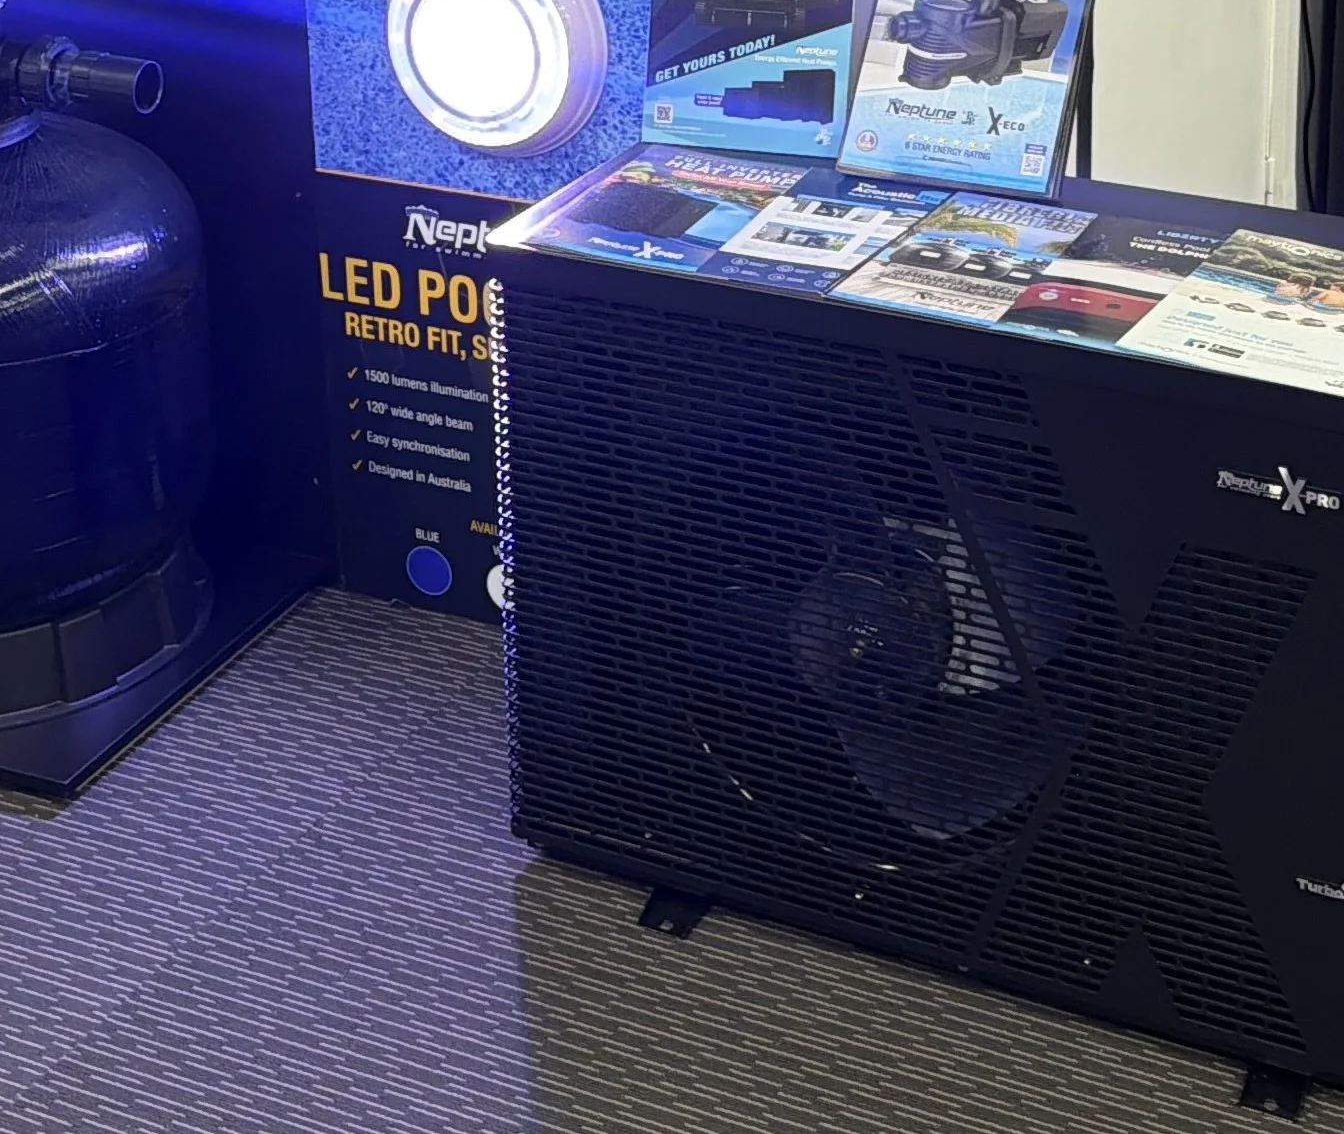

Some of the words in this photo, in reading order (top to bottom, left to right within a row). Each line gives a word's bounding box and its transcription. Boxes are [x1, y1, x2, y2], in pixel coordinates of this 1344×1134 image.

[655, 65, 680, 83] GET
[682, 51, 726, 75] YOURS
[728, 33, 776, 59] TODAY!
[885, 100, 957, 121] Neptune
[986, 106, 1026, 136] X-ECO
[912, 142, 931, 154] STAR
[932, 145, 963, 158] ENERGY
[963, 149, 991, 161] RATING
[664, 158, 724, 177] HEAT
[727, 169, 798, 187] PUMP
[1128, 240, 1157, 252] THE
[1156, 229, 1223, 245] LIBERTY
[1245, 233, 1344, 262] maytronics
[318, 252, 402, 310] LED
[344, 311, 421, 348] RETRO
[426, 325, 468, 362] FIT,
[364, 368, 390, 385] 1500
[391, 373, 429, 392] lumens
[430, 380, 489, 403] illumination
[390, 405, 414, 421] wide
[415, 411, 443, 427] angle
[445, 414, 474, 432] beam
[366, 430, 391, 448] Easy
[391, 435, 471, 463] synchronisation
[368, 460, 414, 481] Designed
[415, 470, 426, 483] in
[427, 474, 472, 493] Australia
[1277, 465, 1341, 515] X-PRO
[415, 527, 441, 544] BLUE
